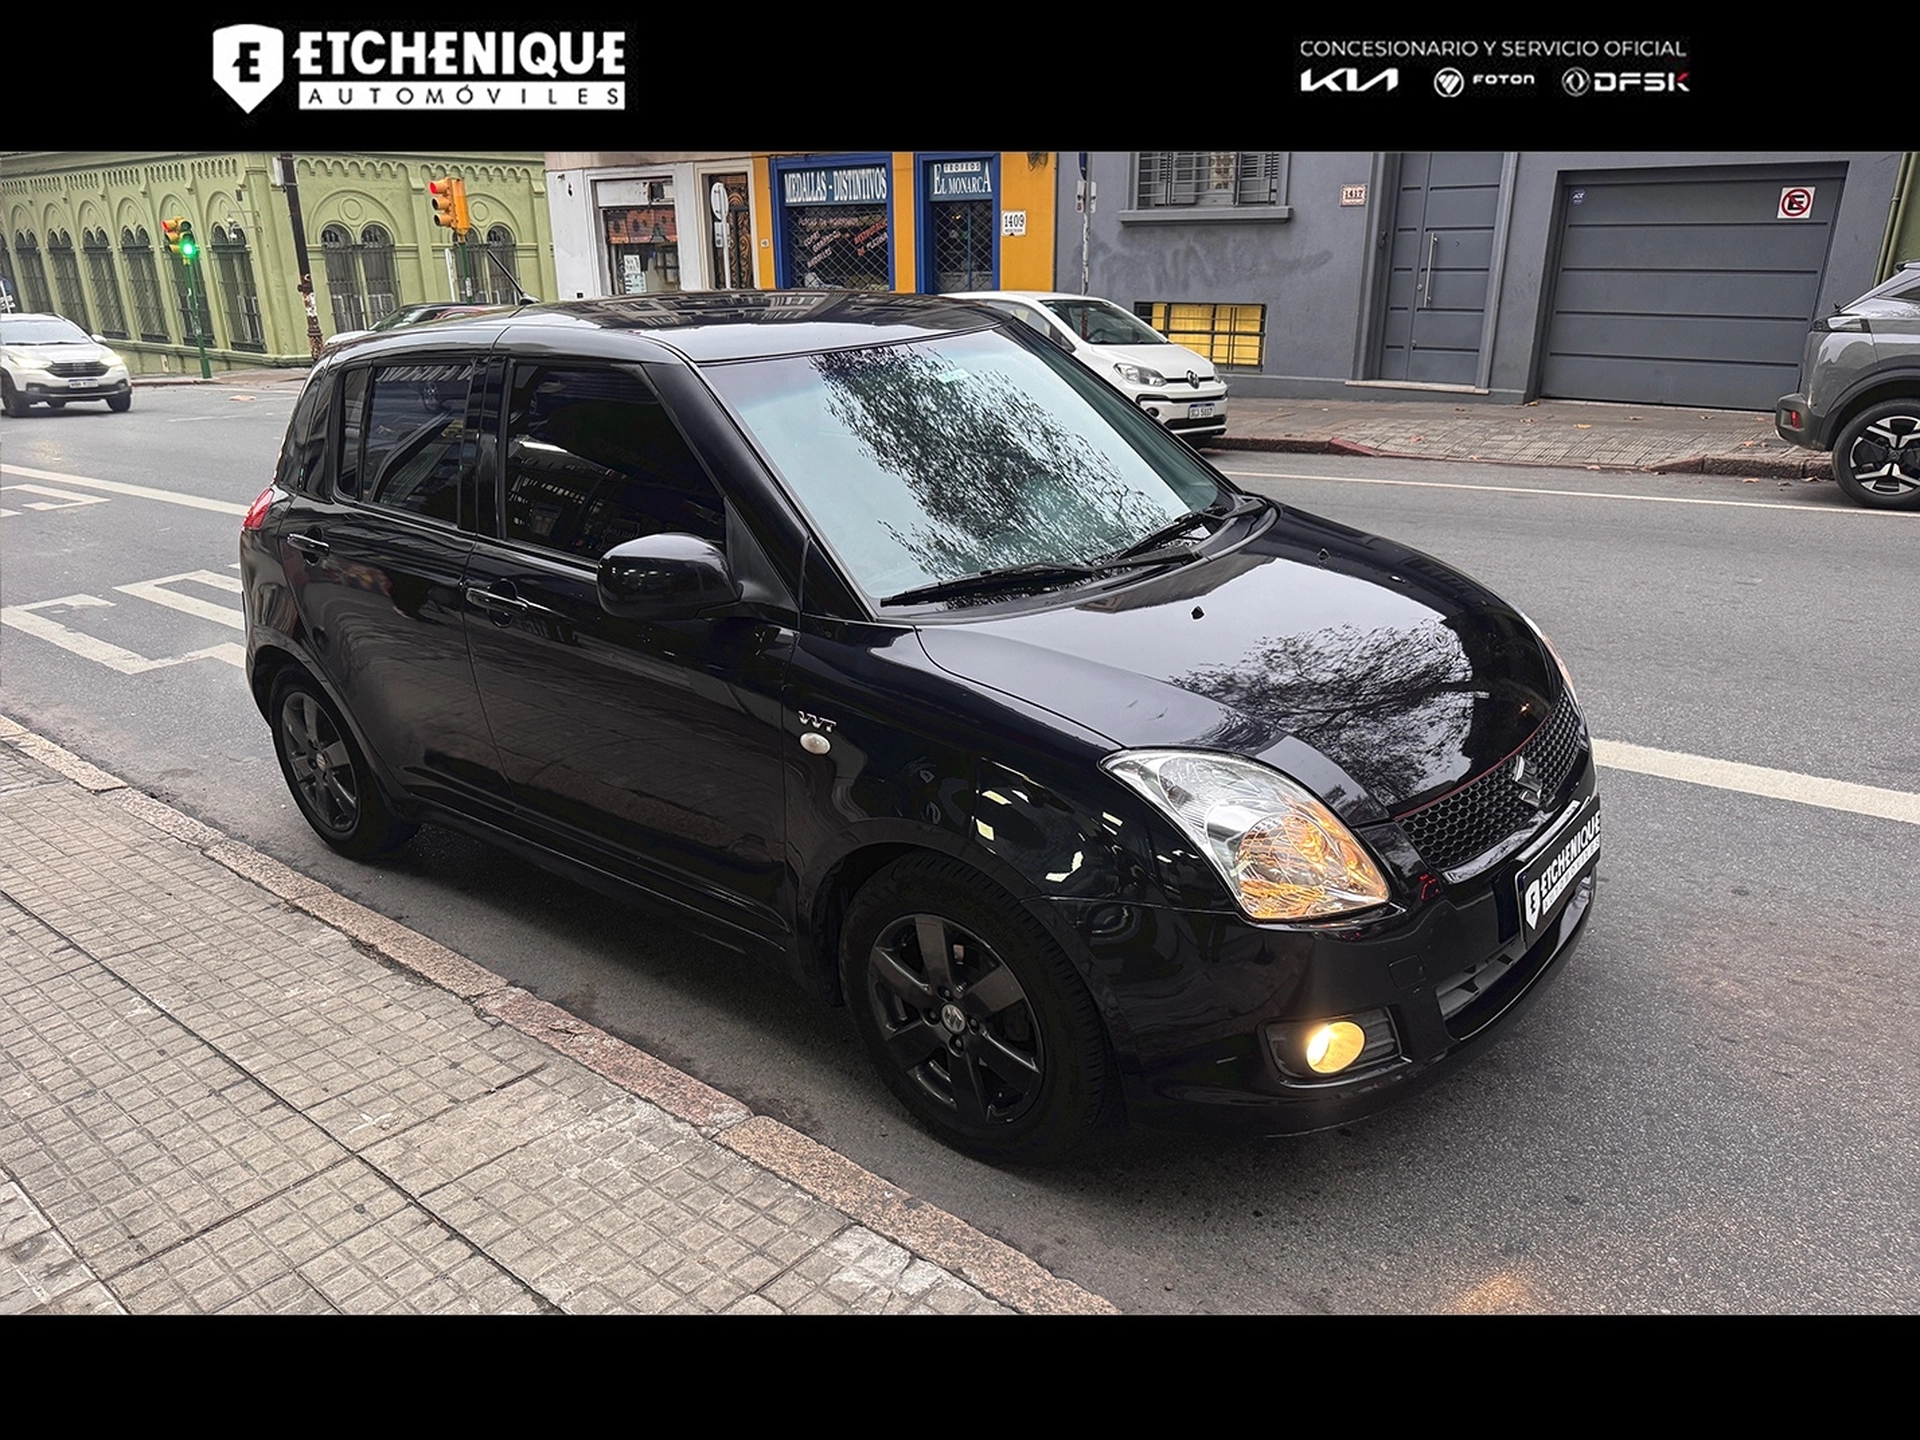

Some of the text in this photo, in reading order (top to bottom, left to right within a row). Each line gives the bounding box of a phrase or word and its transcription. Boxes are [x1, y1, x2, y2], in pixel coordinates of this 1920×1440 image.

[944, 163, 980, 172] TROFEOS
[948, 161, 992, 194] MONARCA
[784, 171, 827, 203] MEDALLAS
[833, 167, 887, 201] DISTINTIVOS
[1004, 214, 1025, 228] 1409
[798, 710, 837, 732] VVT
[1541, 809, 1600, 898] ETCHENIQUE
